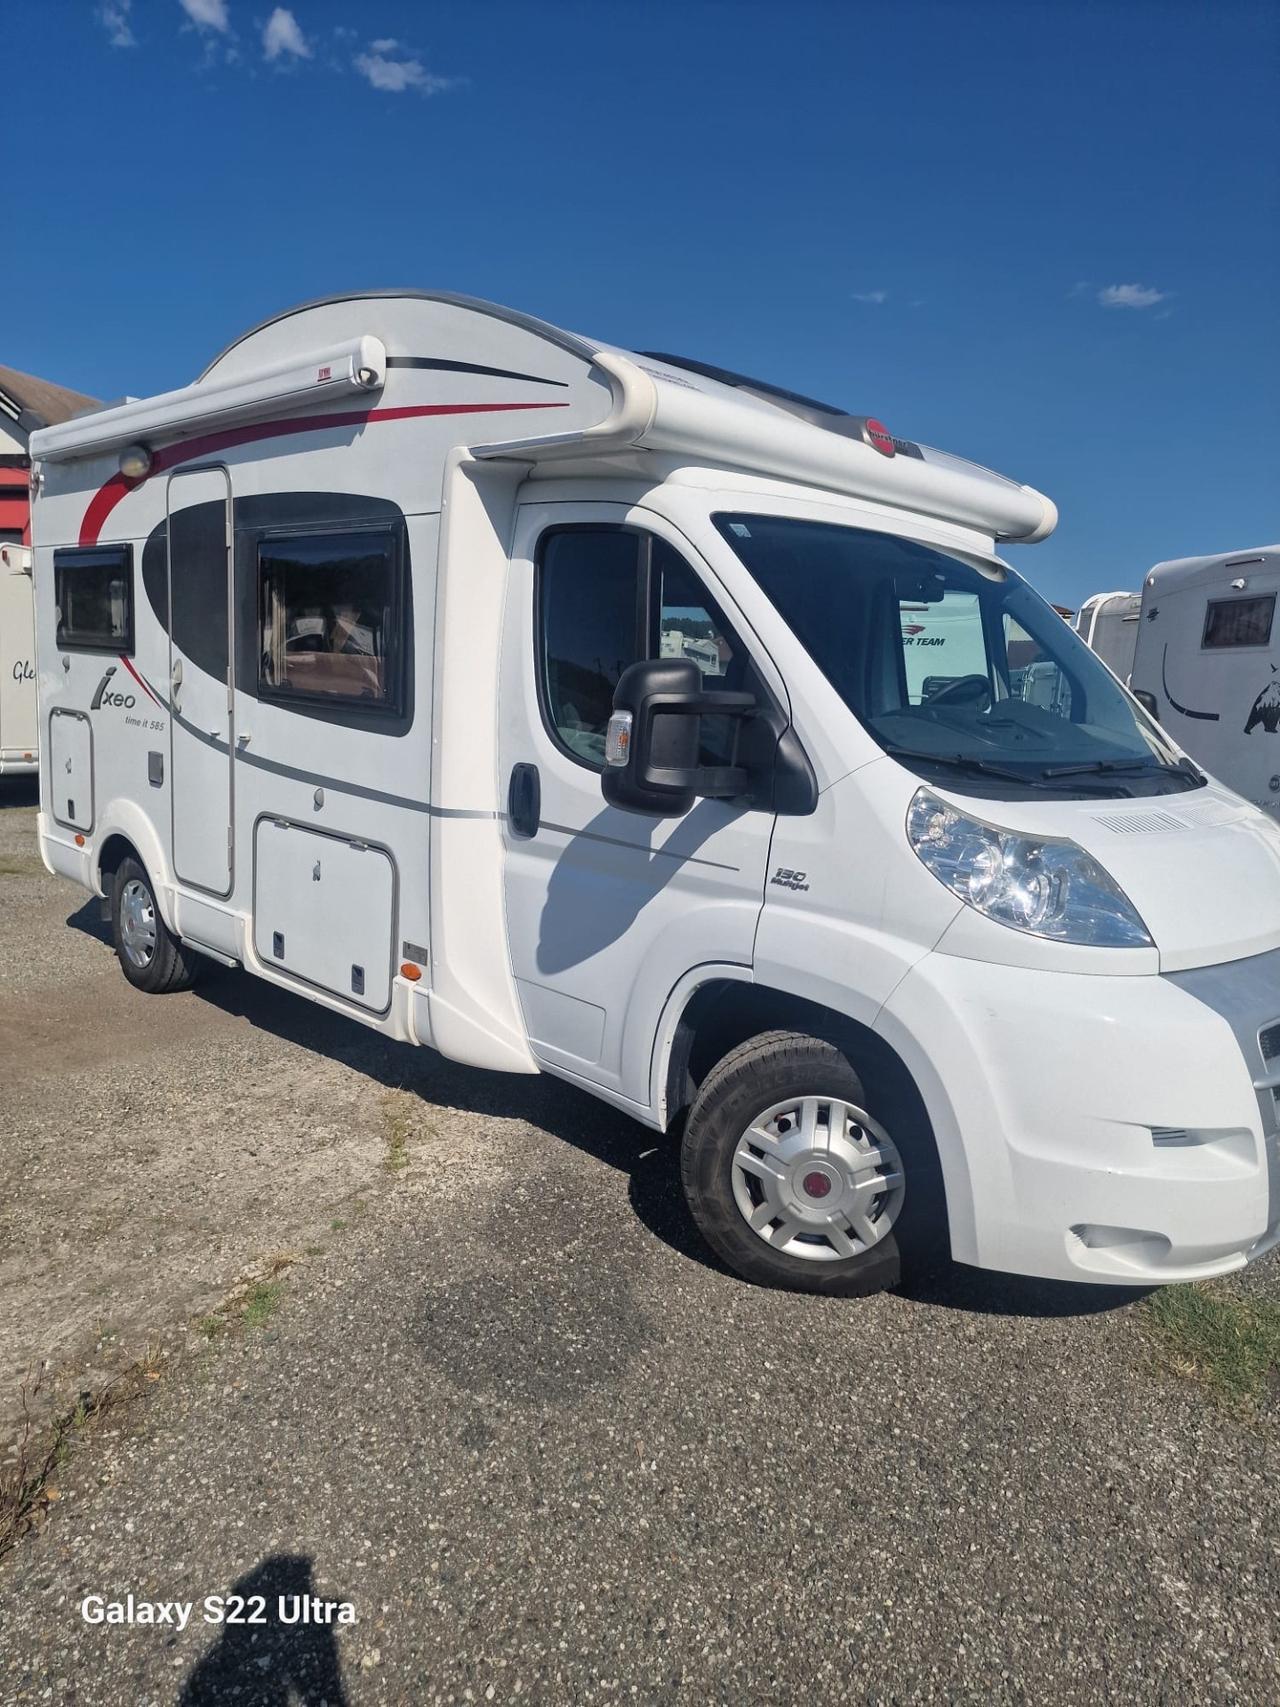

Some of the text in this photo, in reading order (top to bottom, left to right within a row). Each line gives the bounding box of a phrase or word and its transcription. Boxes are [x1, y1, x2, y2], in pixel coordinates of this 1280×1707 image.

[916, 637, 946, 647] TEAM
[125, 715, 165, 731] time it 585
